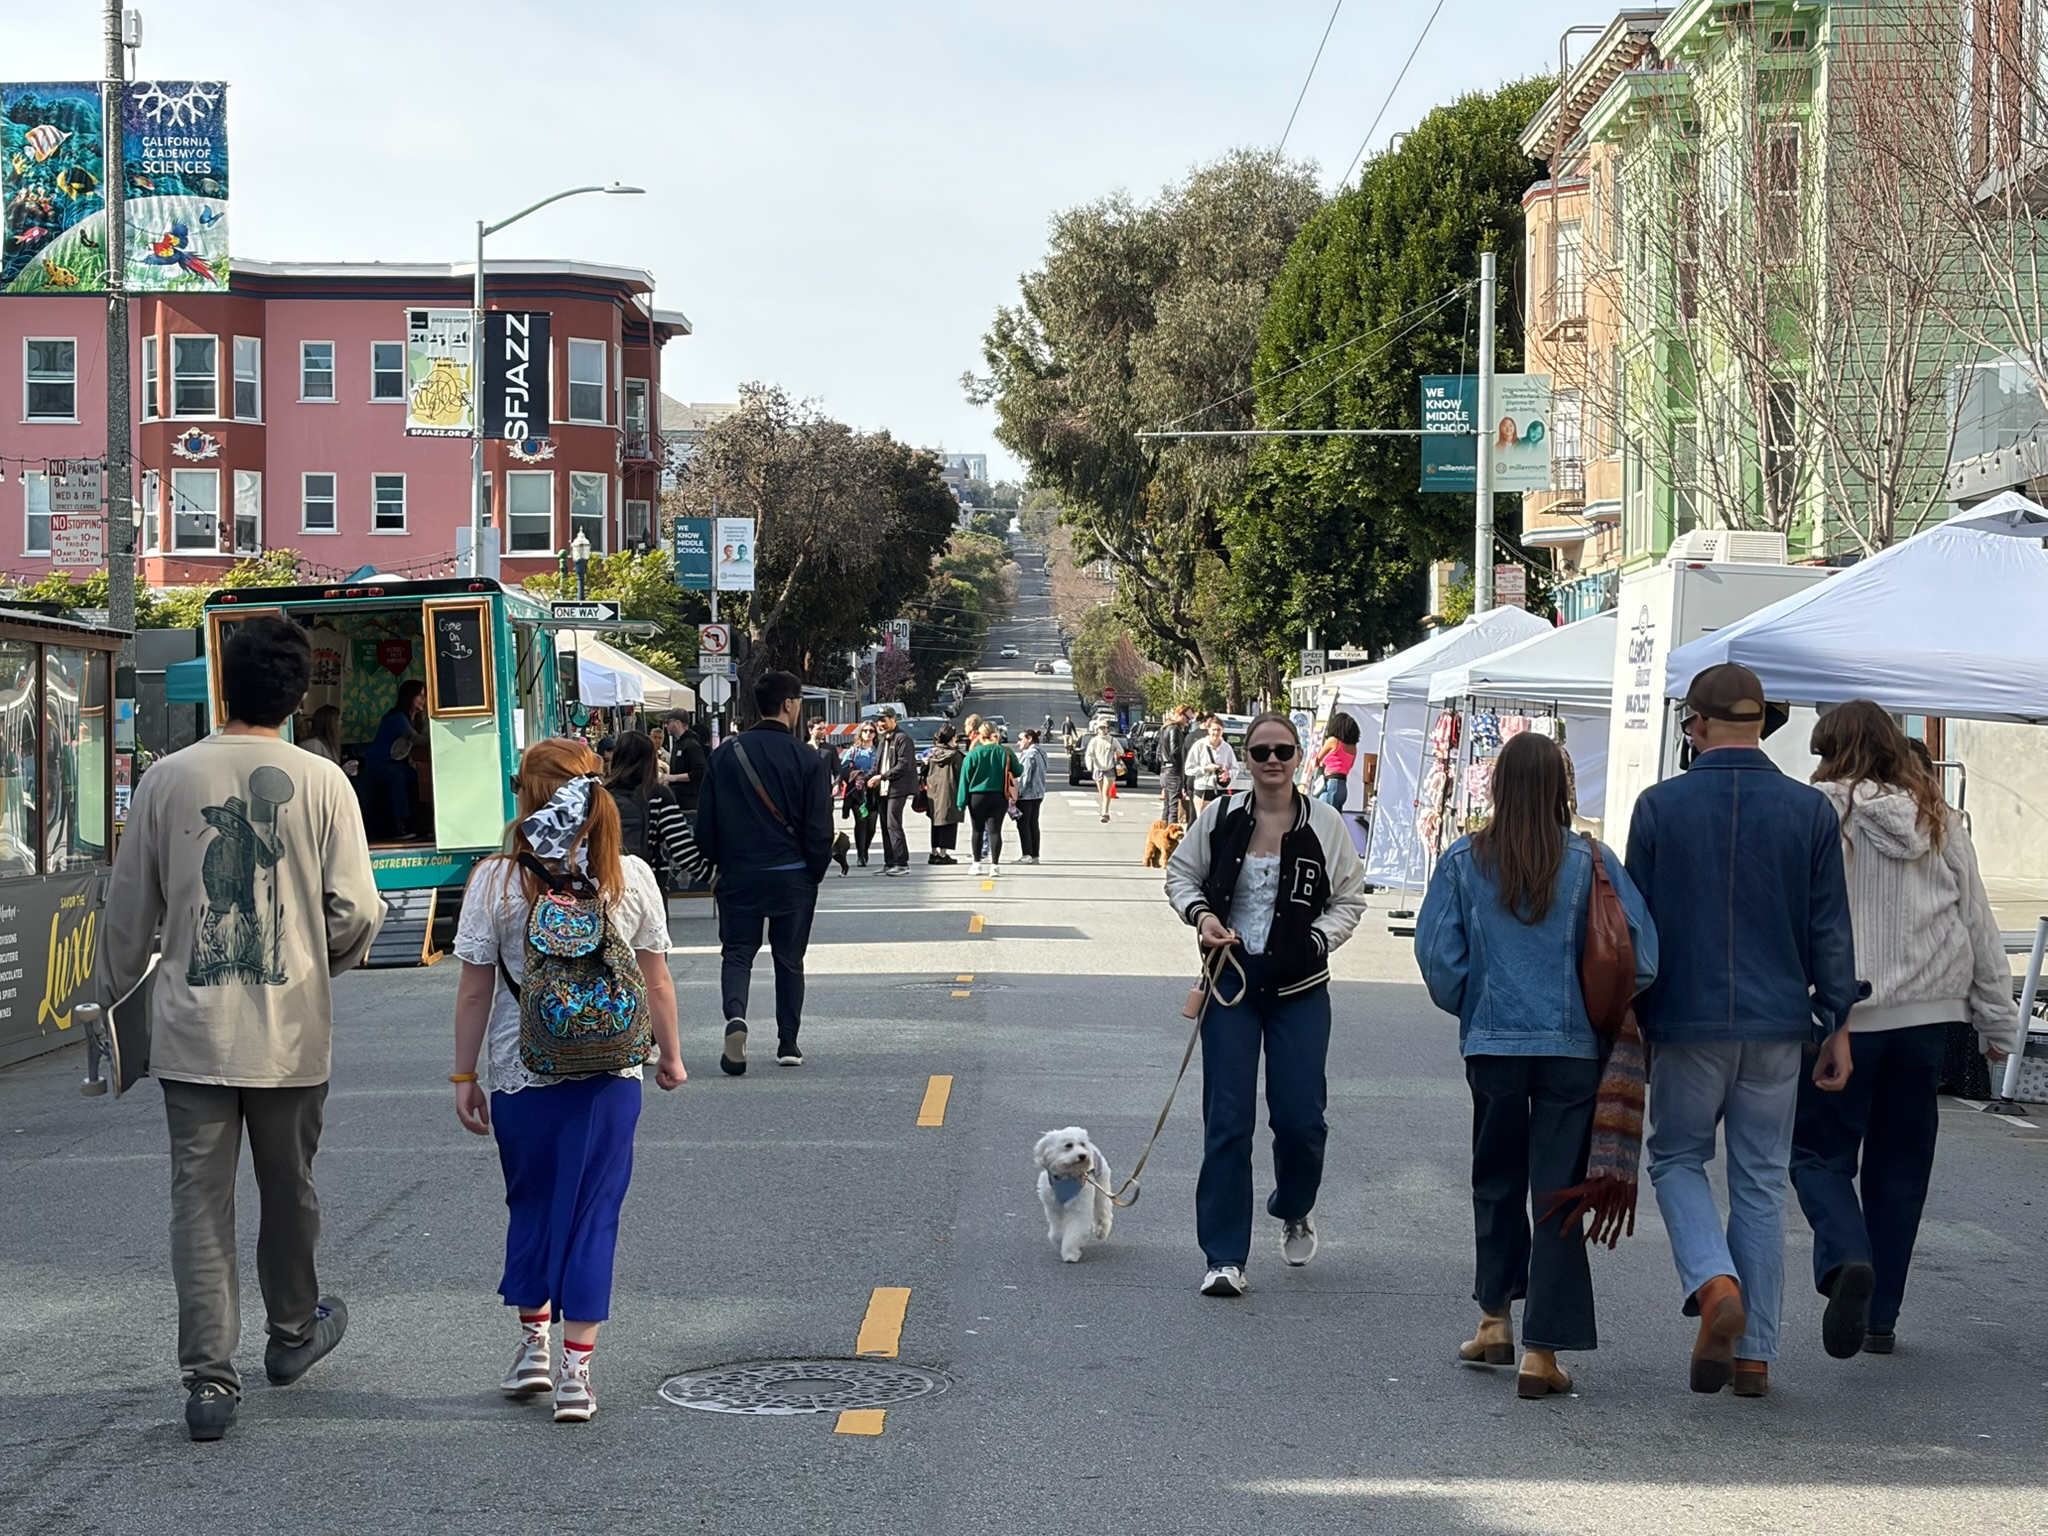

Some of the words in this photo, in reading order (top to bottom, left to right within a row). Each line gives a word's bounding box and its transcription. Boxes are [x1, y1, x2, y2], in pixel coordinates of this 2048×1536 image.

[141, 136, 212, 147] CALIFORNIA
[141, 148, 196, 159] ACADEMY
[196, 148, 212, 159] OF
[142, 160, 212, 174] SCIENCES
[503, 313, 530, 441] SFJAZZ
[1425, 388, 1445, 398] WE
[1425, 400, 1462, 410] KNOW
[1425, 411, 1469, 421] MIDDLE
[411, 429, 468, 438] SFJAZZ.ORG
[51, 461, 65, 475] NO
[1438, 464, 1476, 472] millennium
[55, 491, 71, 500] WED
[73, 492, 79, 500] &
[82, 491, 95, 500] FRI
[52, 516, 67, 530] NO
[68, 520, 102, 530] STOPPING
[54, 533, 71, 542] 4PM
[52, 548, 71, 557] 10AM
[79, 548, 98, 557] 10PM
[556, 608, 576, 618] ONE
[579, 608, 599, 618] WAY
[438, 618, 462, 632] Come
[449, 632, 460, 641] On
[454, 642, 467, 652] In
[1304, 665, 1323, 676] 20
[371, 856, 453, 870] OSTREATERY.COM
[1290, 857, 1322, 907] B
[60, 895, 76, 909] SAVOR
[76, 894, 85, 907] THE
[38, 911, 96, 1030] Luxe
